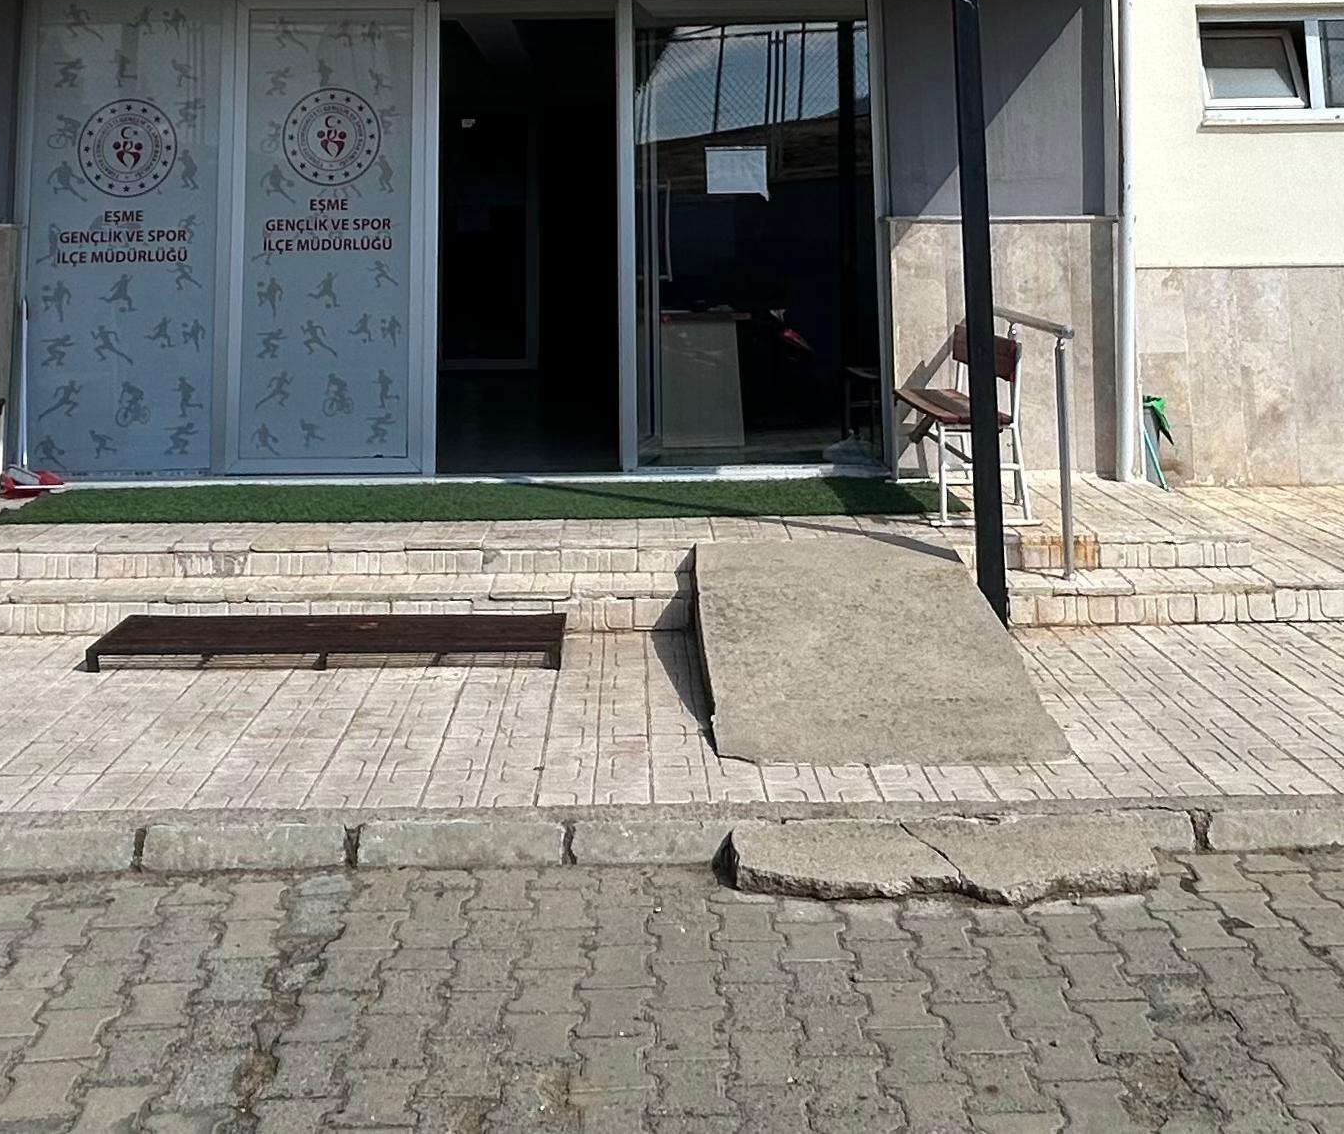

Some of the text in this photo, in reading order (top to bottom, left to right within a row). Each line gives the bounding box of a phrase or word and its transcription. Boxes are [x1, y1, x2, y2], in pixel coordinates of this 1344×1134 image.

[309, 198, 349, 214] EŞME
[103, 209, 144, 226] EŞME
[264, 217, 392, 234] GENÇLİK VE SPOR
[58, 228, 188, 246] GENÇLİK VE SPOR
[262, 234, 393, 255] İLÇE MÜDÜRLÜĞÜ
[56, 246, 188, 267] İLÇE MÜDÜRLÜĞÜ
